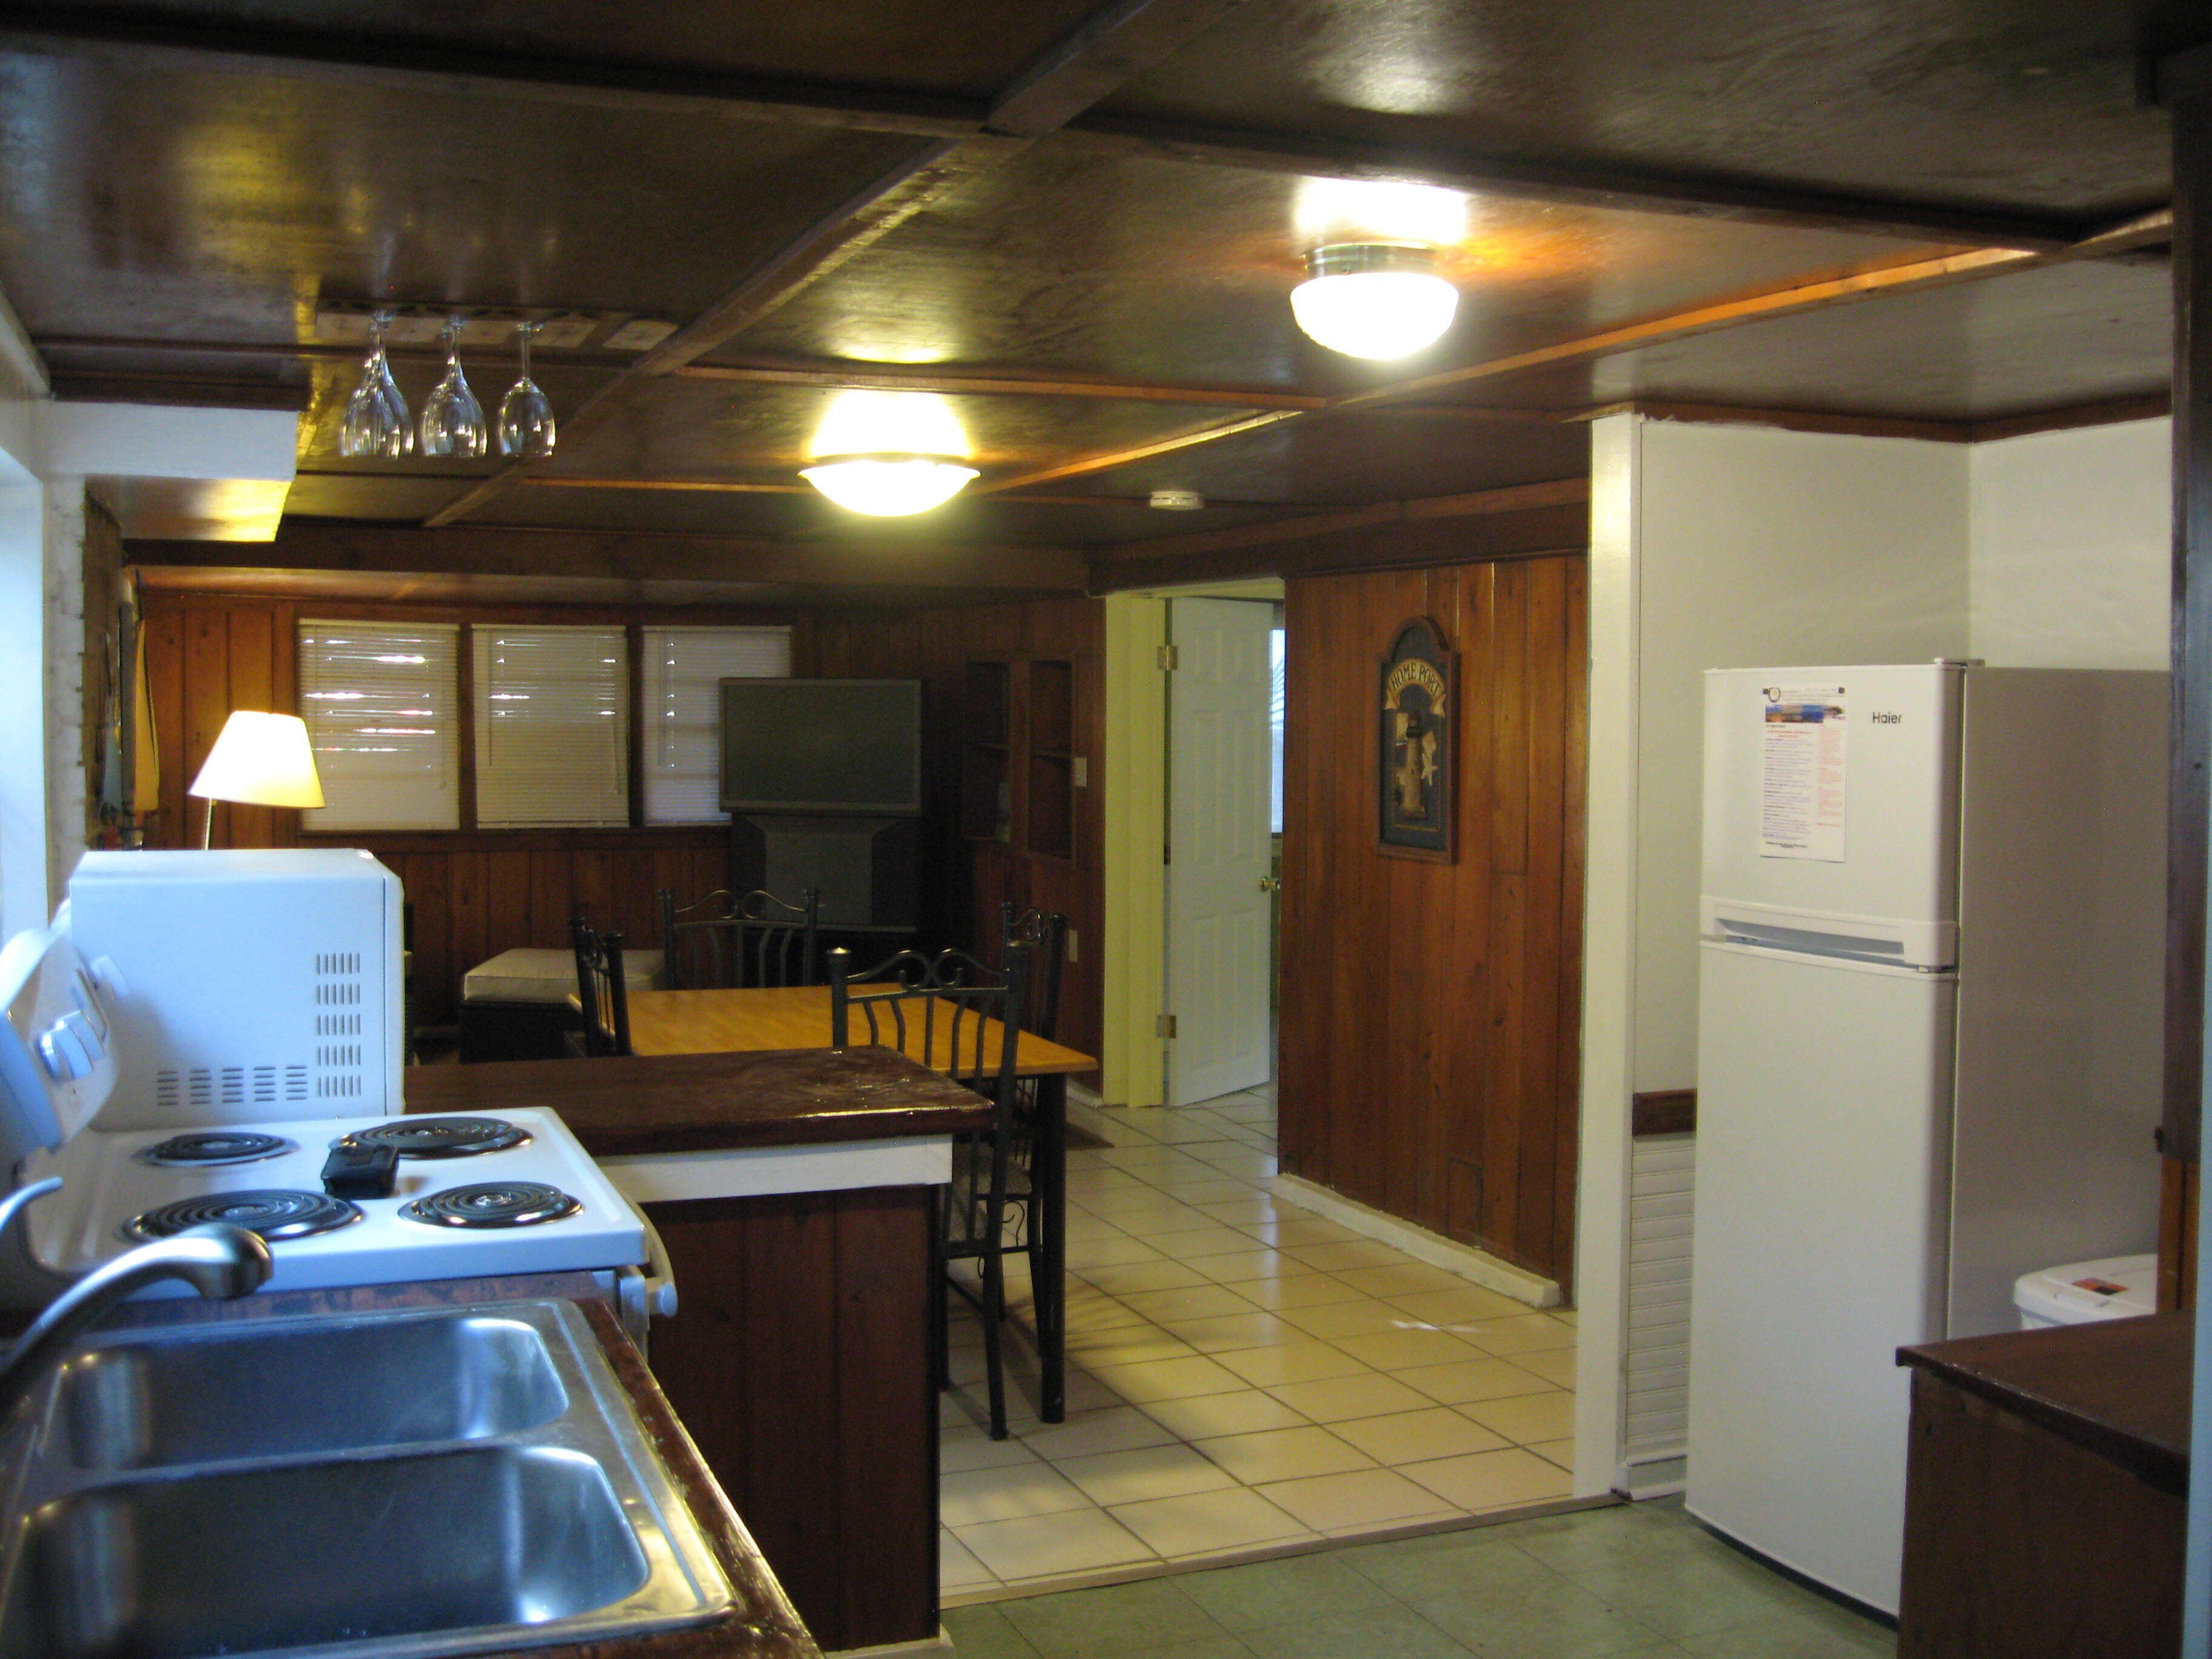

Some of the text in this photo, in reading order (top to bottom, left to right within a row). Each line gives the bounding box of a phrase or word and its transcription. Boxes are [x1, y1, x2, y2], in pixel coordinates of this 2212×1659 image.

[1392, 664, 1441, 695] HOME PORT
[1872, 712, 1902, 724] Haier
